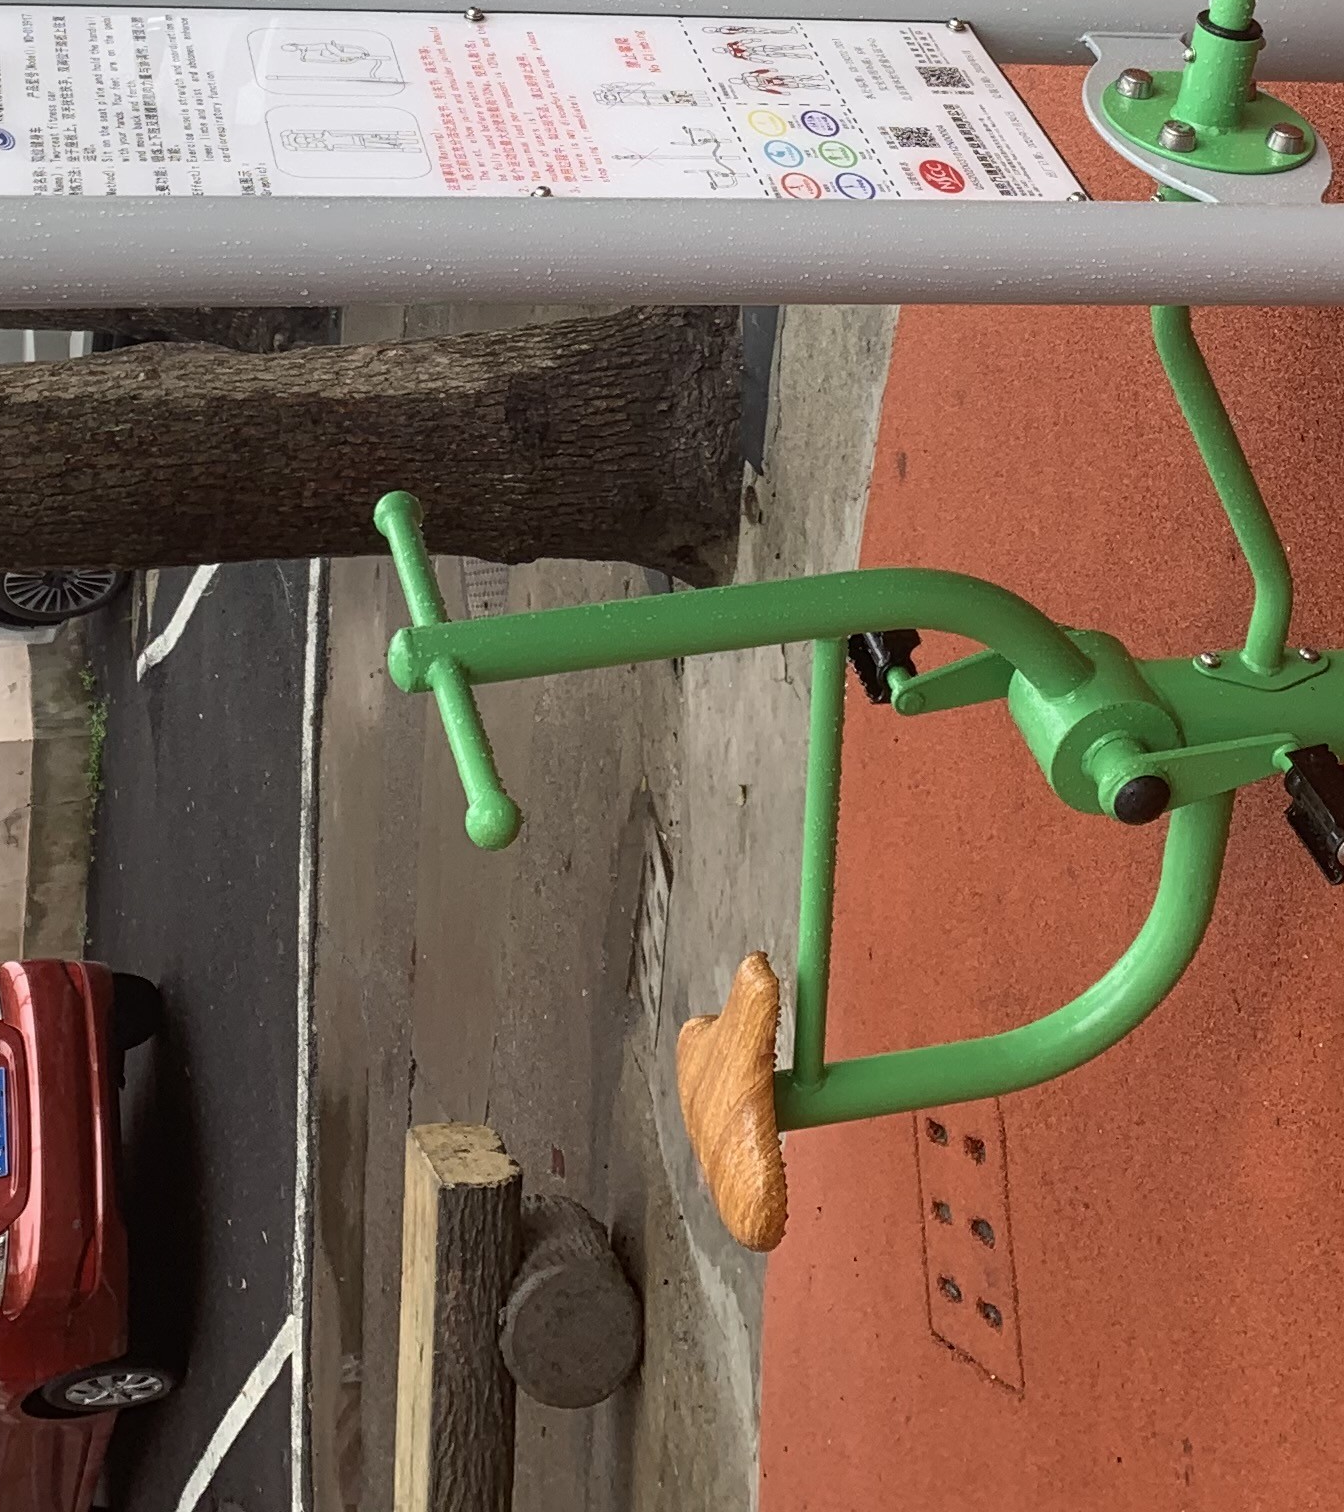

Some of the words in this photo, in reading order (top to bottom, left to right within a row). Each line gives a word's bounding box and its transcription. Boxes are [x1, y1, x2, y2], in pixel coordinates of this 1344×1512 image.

[177, 18, 192, 40] enhance
[426, 27, 443, 46] should
[102, 36, 114, 45] the
[163, 24, 180, 63] coordination
[479, 38, 491, 48] and
[522, 31, 541, 51] please
[629, 30, 659, 62] Climbing
[88, 45, 99, 55] the
[89, 57, 101, 72] hold
[108, 62, 118, 72] are
[171, 66, 182, 76] and
[647, 65, 662, 73] No
[91, 74, 103, 85] and
[108, 78, 120, 90] feet
[187, 72, 199, 83] and
[440, 67, 460, 92] shoulder
[539, 69, 557, 89] during
[46, 91, 56, 102] car
[93, 88, 107, 106] plate
[110, 94, 122, 106] Your
[173, 79, 189, 106] strength
[189, 89, 204, 106] waist
[450, 94, 463, 105] and
[128, 101, 140, 112] and
[546, 92, 572, 126] discomfort
[44, 105, 58, 130] fitness
[97, 109, 107, 122] seat
[177, 109, 192, 131] muscle
[194, 109, 206, 120] and
[471, 111, 490, 133] before
[507, 112, 521, 122] per
[129, 115, 142, 130] back
[97, 126, 109, 137] the
[117, 132, 130, 146] your
[195, 123, 210, 140] limbs
[208, 103, 233, 163] cardiorespiratory
[461, 126, 478, 144] elbow
[510, 125, 526, 139] load
[531, 129, 545, 147] users
[564, 130, 578, 140] any
[102, 140, 111, 148] on
[134, 133, 145, 148] move
[117, 148, 129, 163] with
[181, 134, 198, 163] Exercise
[199, 145, 214, 162] lower
[586, 147, 605, 165] using
[100, 152, 113, 163] Sit
[135, 151, 147, 162] and
[487, 153, 505, 170] fully
[572, 154, 589, 172] there
[476, 171, 491, 181] The
[527, 171, 542, 182] The
[541, 161, 559, 182] number
[594, 168, 612, 183] stop
[918, 164, 961, 190] NSCC
